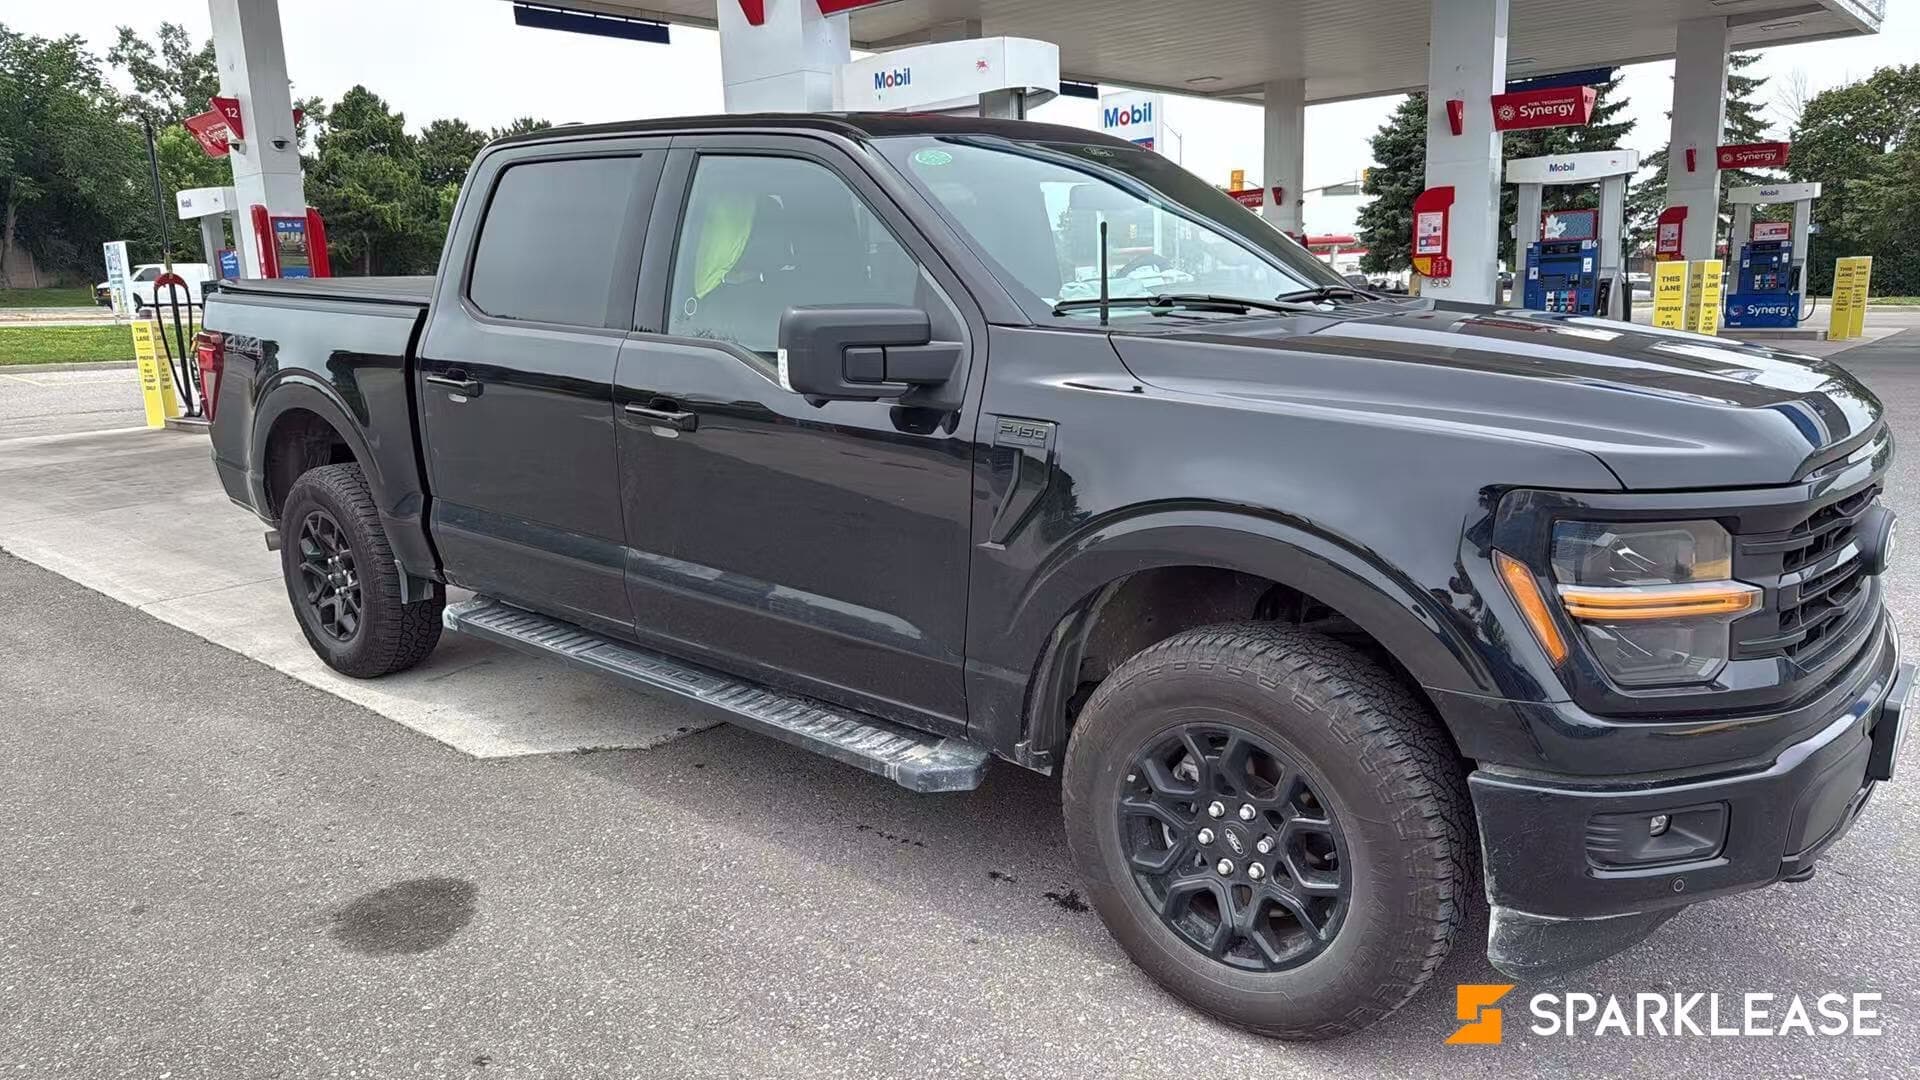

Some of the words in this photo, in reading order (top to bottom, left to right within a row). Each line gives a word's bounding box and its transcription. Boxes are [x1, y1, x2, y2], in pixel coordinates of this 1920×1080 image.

[874, 67, 911, 90] Mobil
[225, 107, 238, 118] 12
[1104, 102, 1152, 129] Mobil
[1519, 103, 1576, 119] Synergy
[1736, 152, 1777, 163] Synergy
[1549, 162, 1576, 173] Mobil
[1661, 275, 1681, 283] THIS
